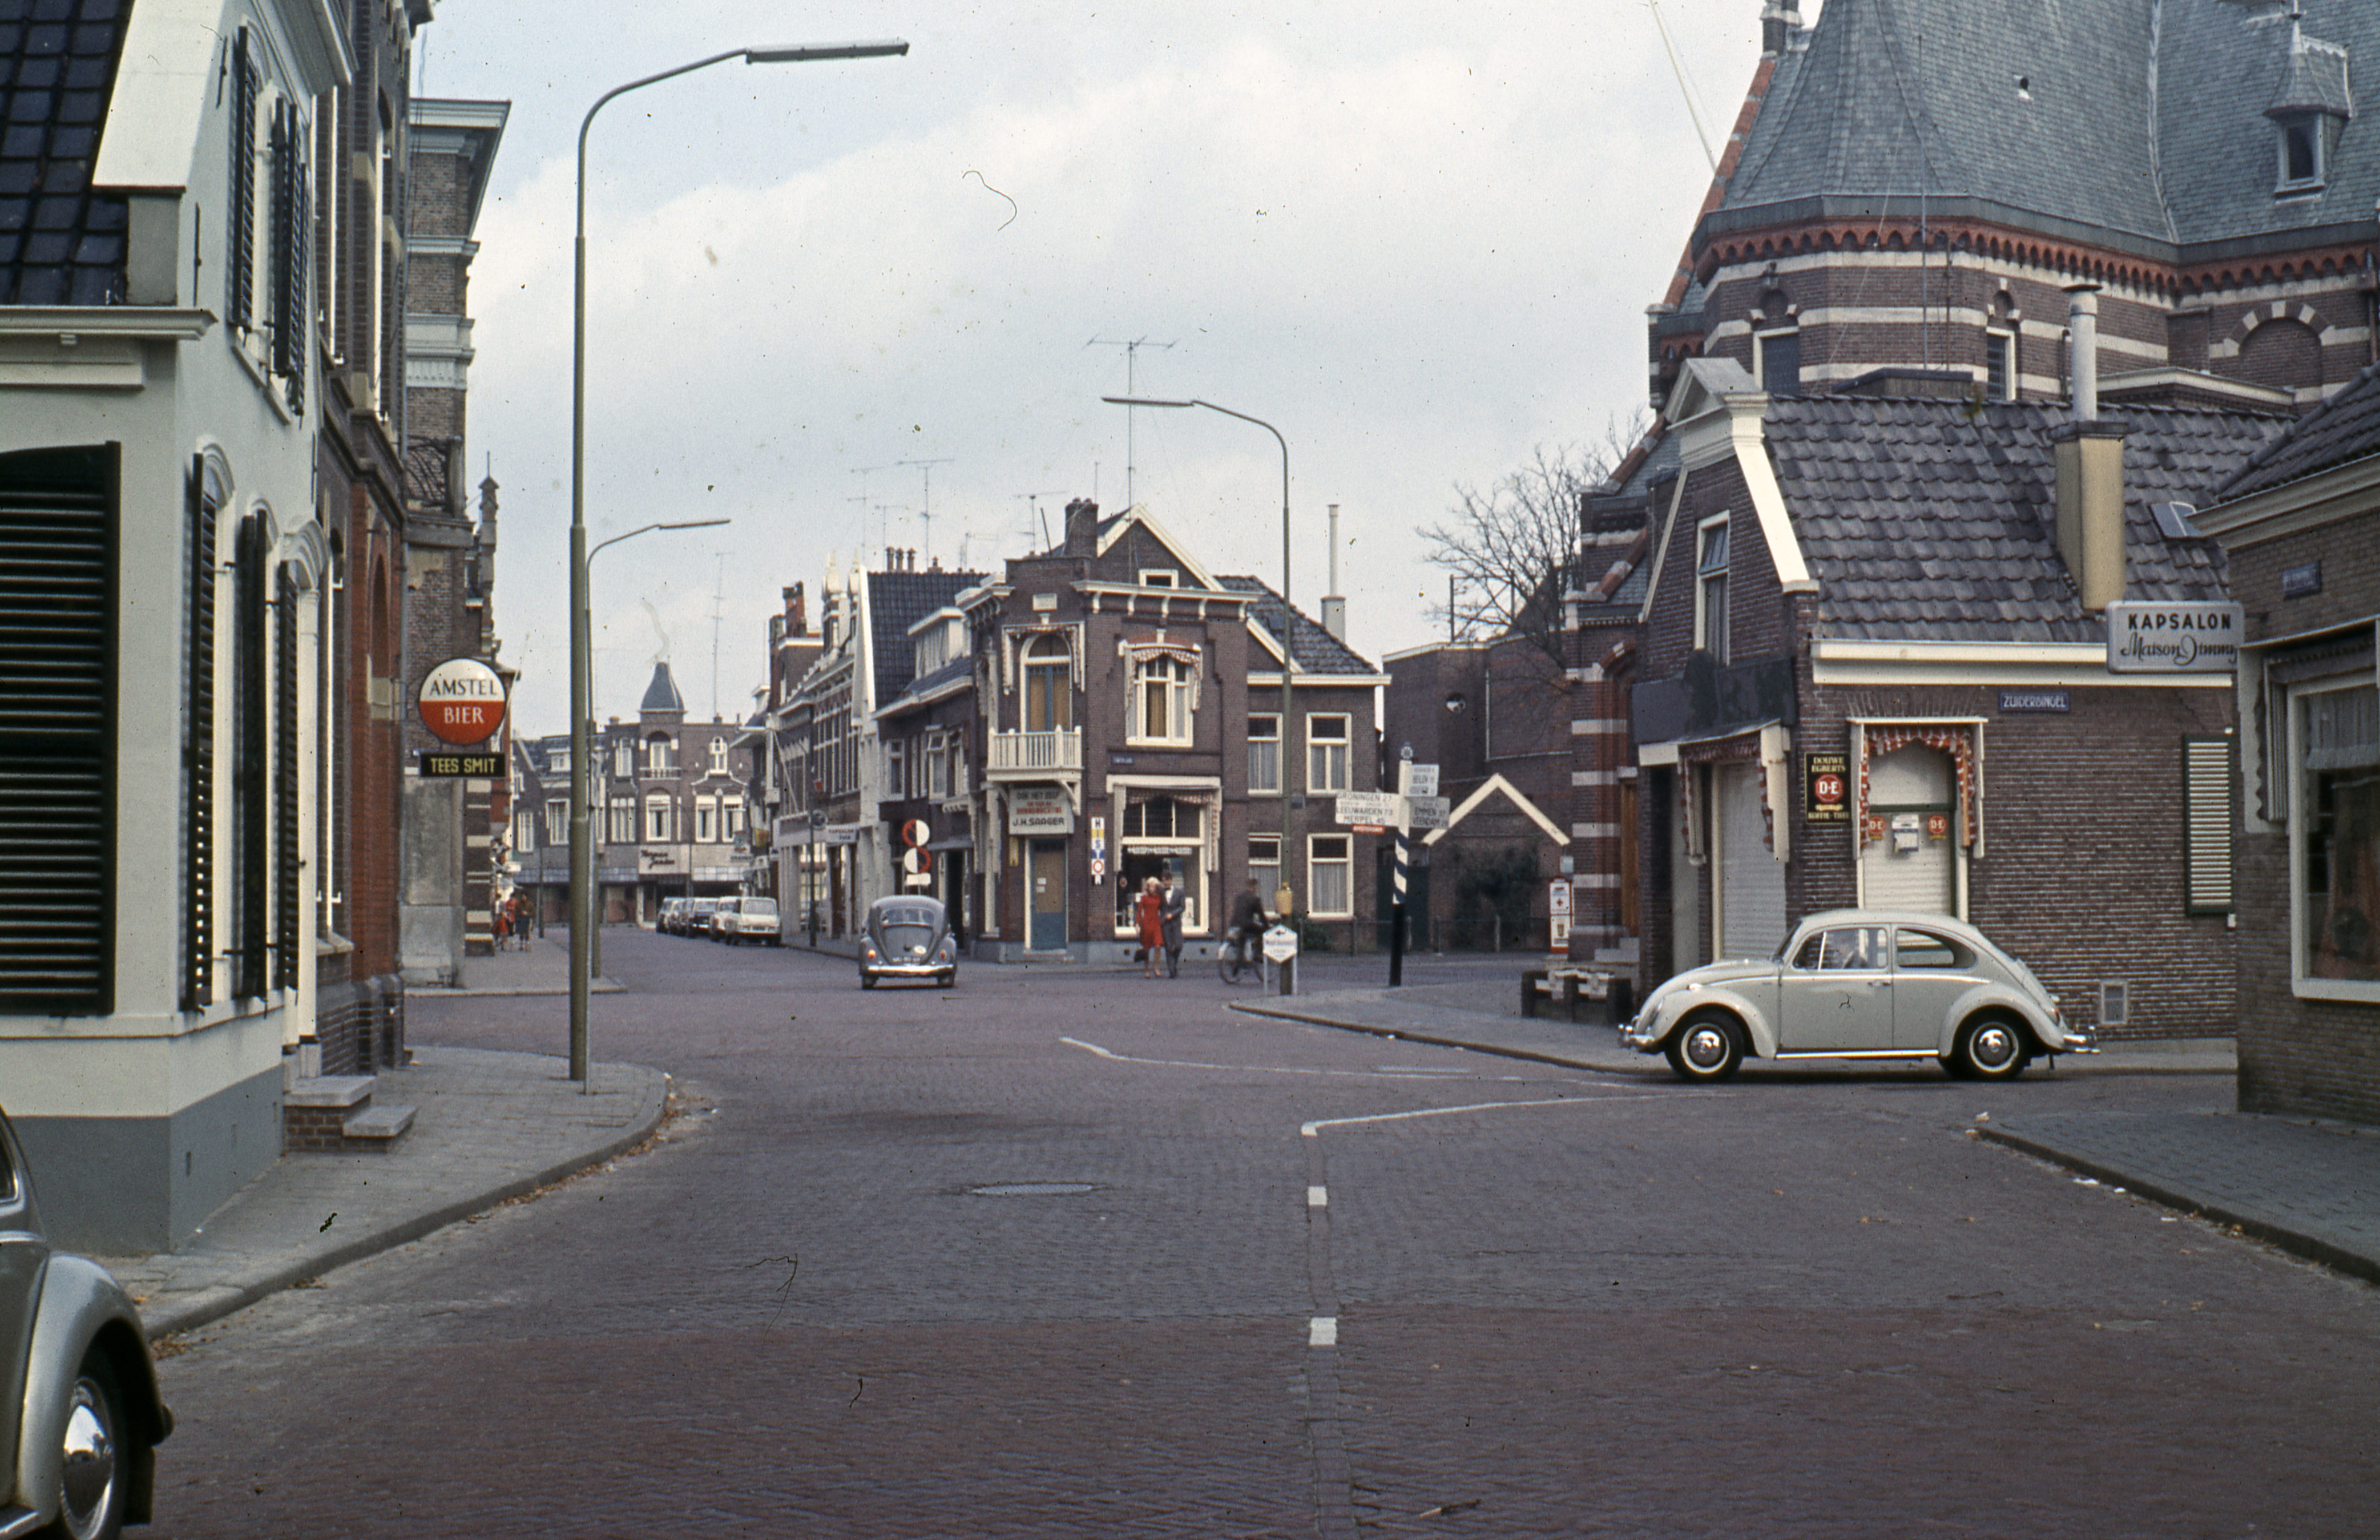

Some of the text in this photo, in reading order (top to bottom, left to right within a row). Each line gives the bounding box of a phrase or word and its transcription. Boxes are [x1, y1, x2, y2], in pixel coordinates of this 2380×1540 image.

[2128, 612, 2231, 630] KAPSALON
[2120, 631, 2181, 662] Maison
[429, 679, 497, 696] AMSTEL
[2004, 695, 2066, 708] ZUIDERSINGEL
[443, 707, 485, 724] BIER
[430, 757, 496, 774] TEES SMIT
[1813, 756, 1844, 765] DOUWE
[1337, 792, 1380, 801] GRONINGEN
[1336, 806, 1382, 816] LEEUWARDEN
[1414, 807, 1437, 816] EMMEN
[1413, 816, 1440, 827] VEENDAM
